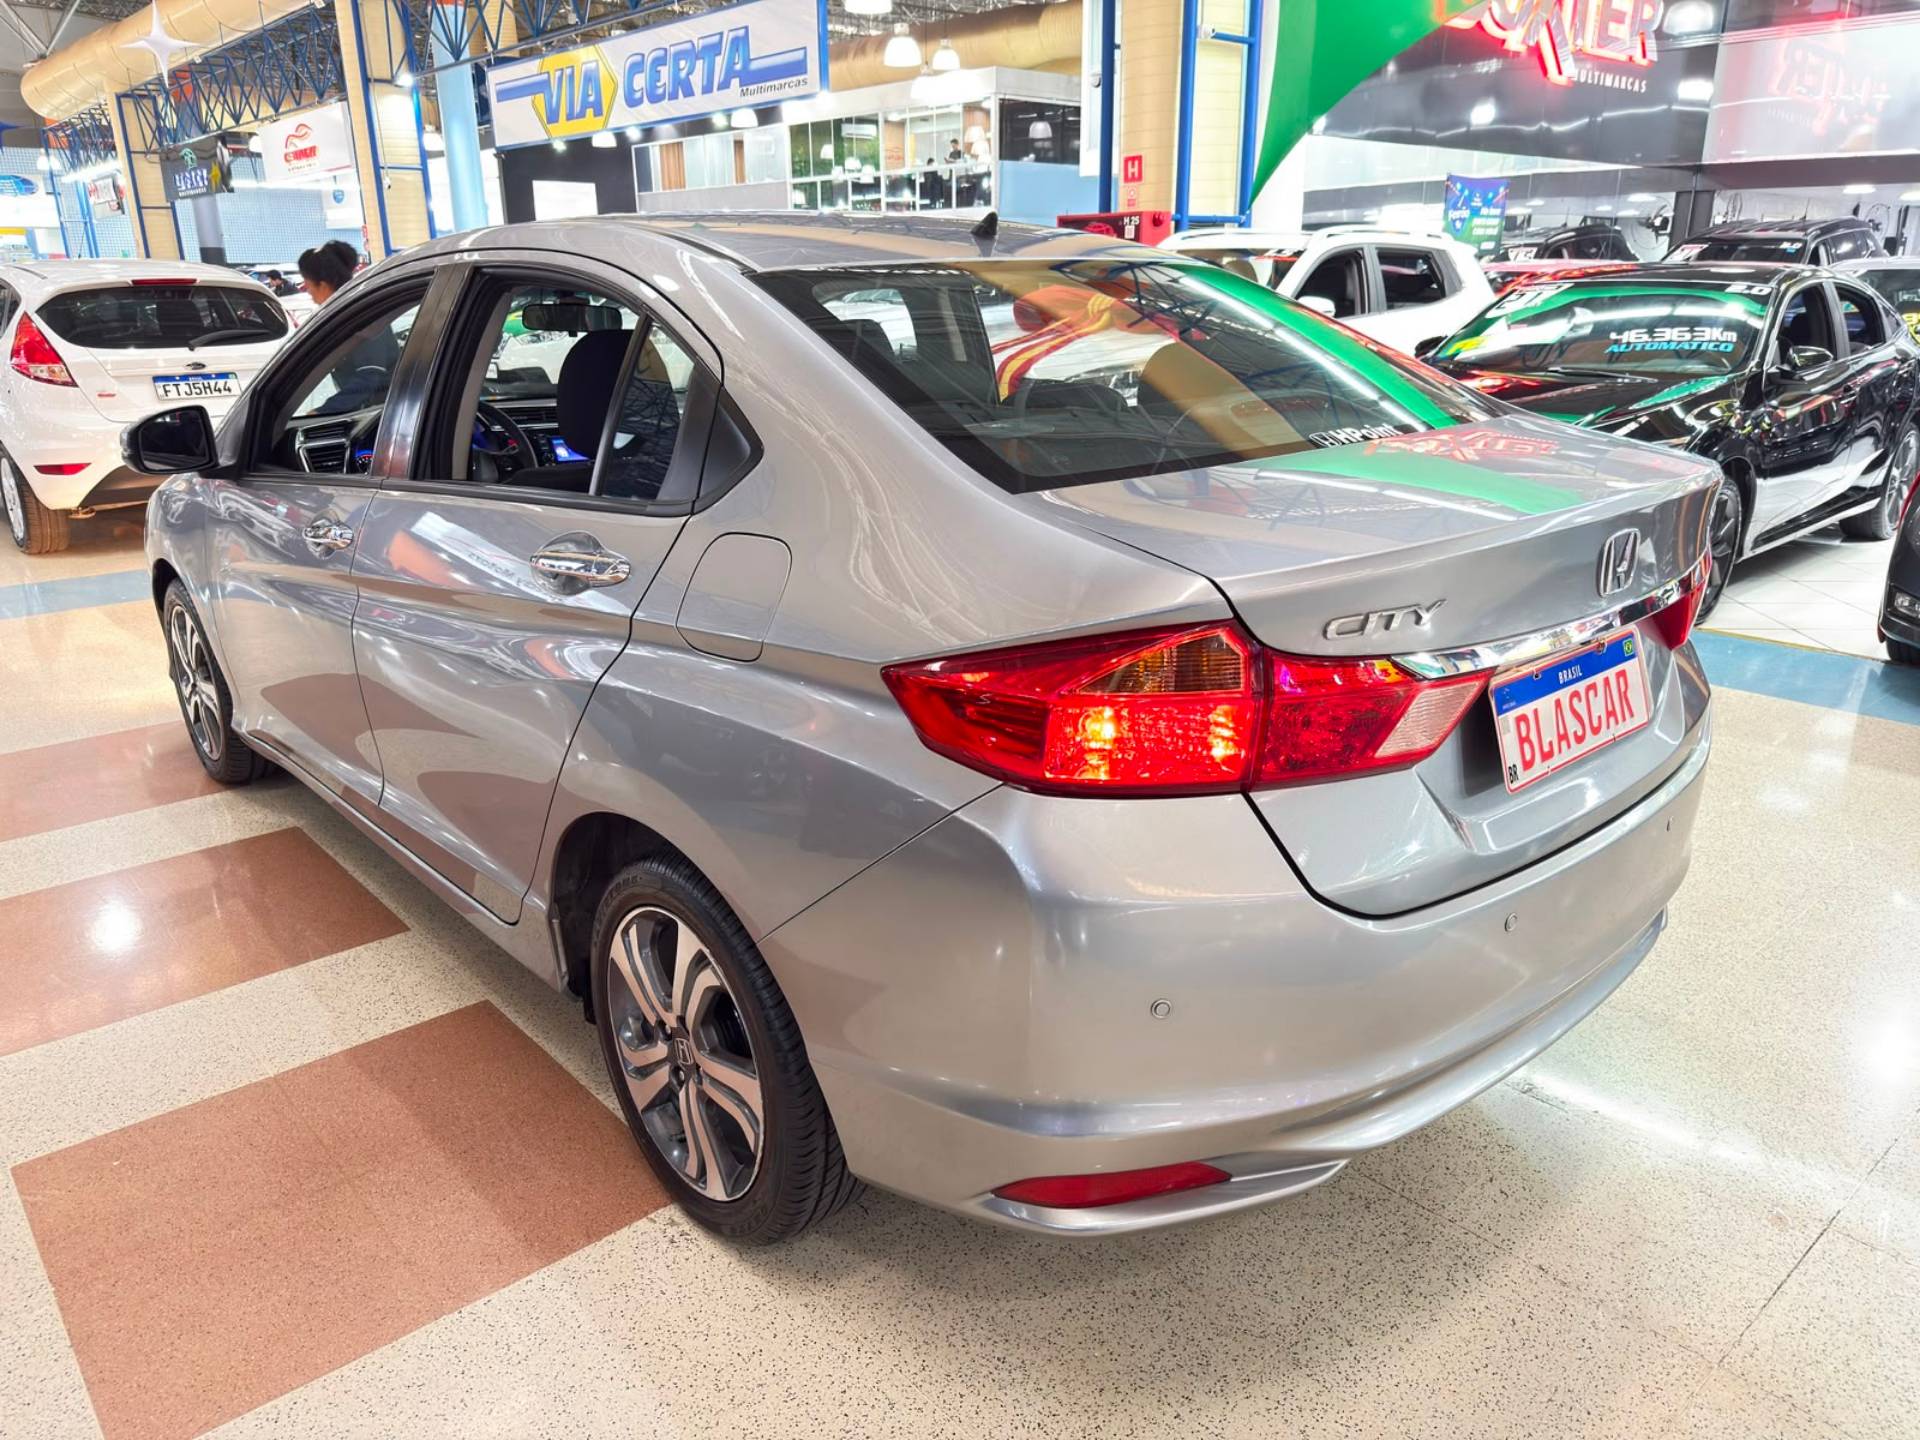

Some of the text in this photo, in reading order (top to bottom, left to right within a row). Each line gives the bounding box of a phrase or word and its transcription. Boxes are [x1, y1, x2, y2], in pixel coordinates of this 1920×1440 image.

[545, 25, 751, 125] VIA CERTA
[739, 77, 809, 98] Multimarcas
[162, 381, 232, 397] FTJ5H44
[1322, 598, 1447, 640] CITY
[1558, 664, 1583, 684] BRASIL
[1514, 669, 1634, 772] BLASCAR
[1508, 764, 1519, 784] BR
